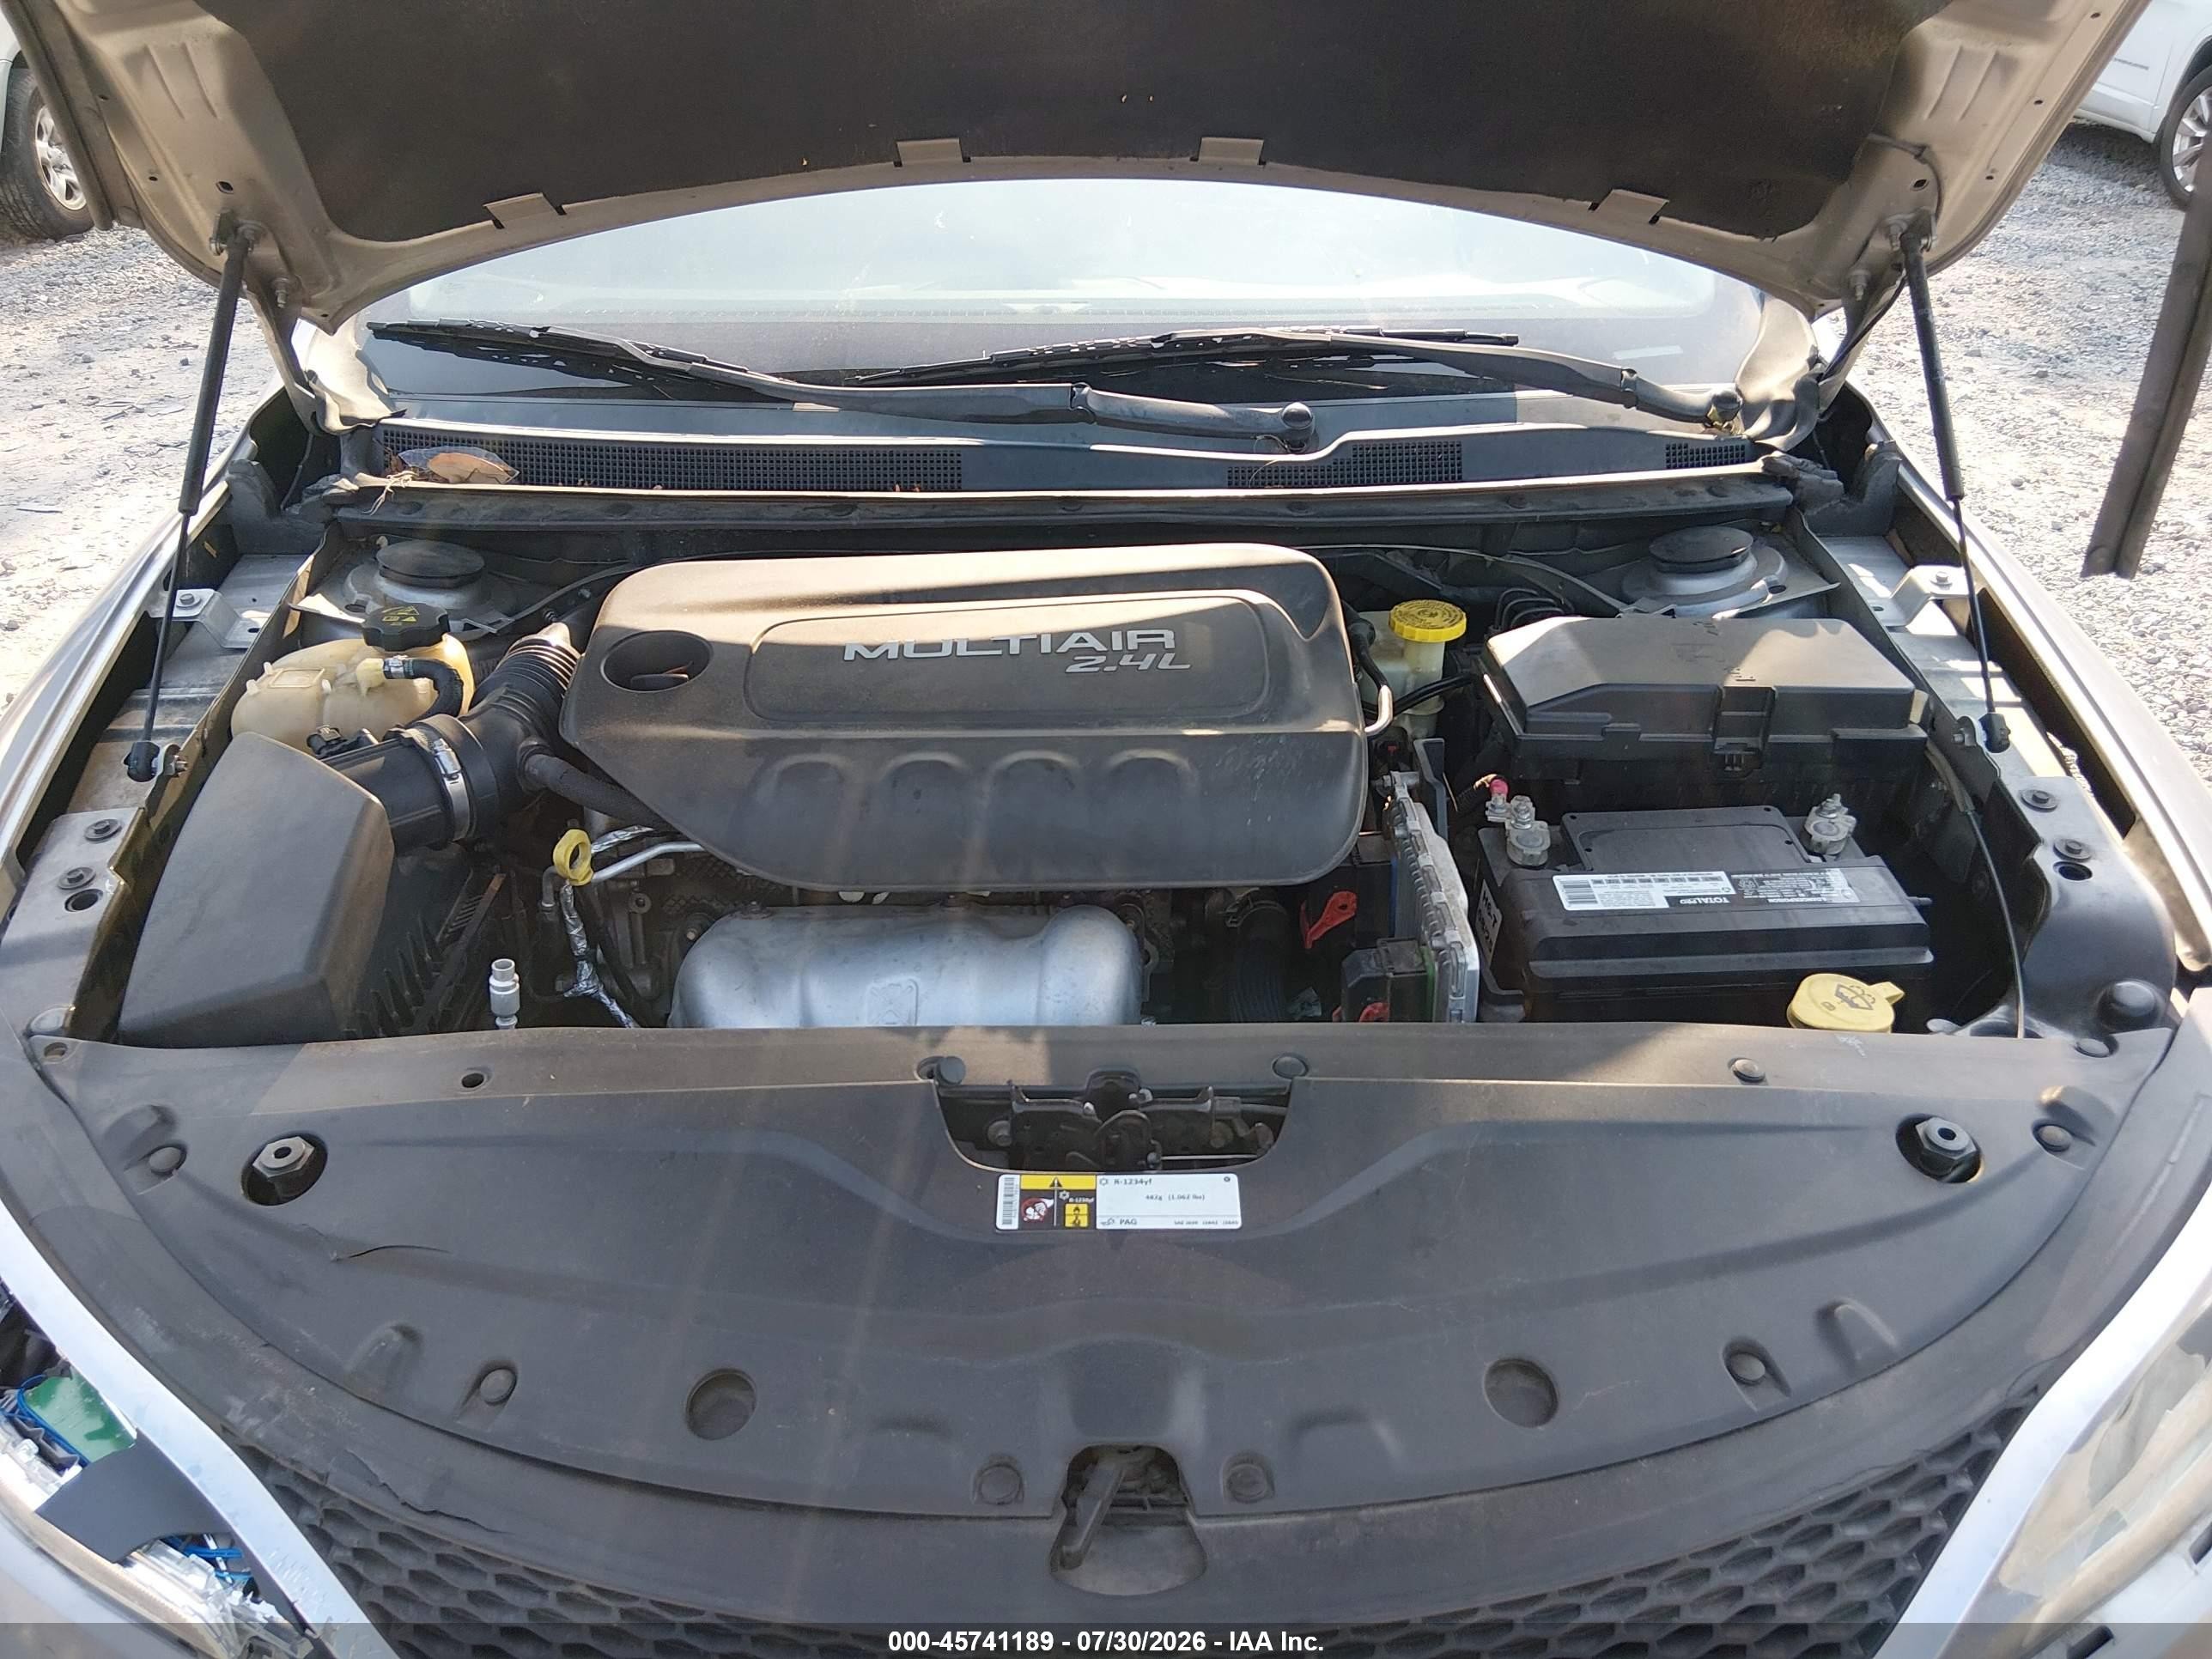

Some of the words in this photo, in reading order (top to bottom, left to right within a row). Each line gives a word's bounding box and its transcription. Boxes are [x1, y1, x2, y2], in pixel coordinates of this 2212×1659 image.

[842, 629, 1176, 661] MULTIAIR
[1065, 652, 1192, 674] 2.4L
[1113, 1177, 1152, 1186] R-1234yf
[1119, 1218, 1138, 1226] PAG
